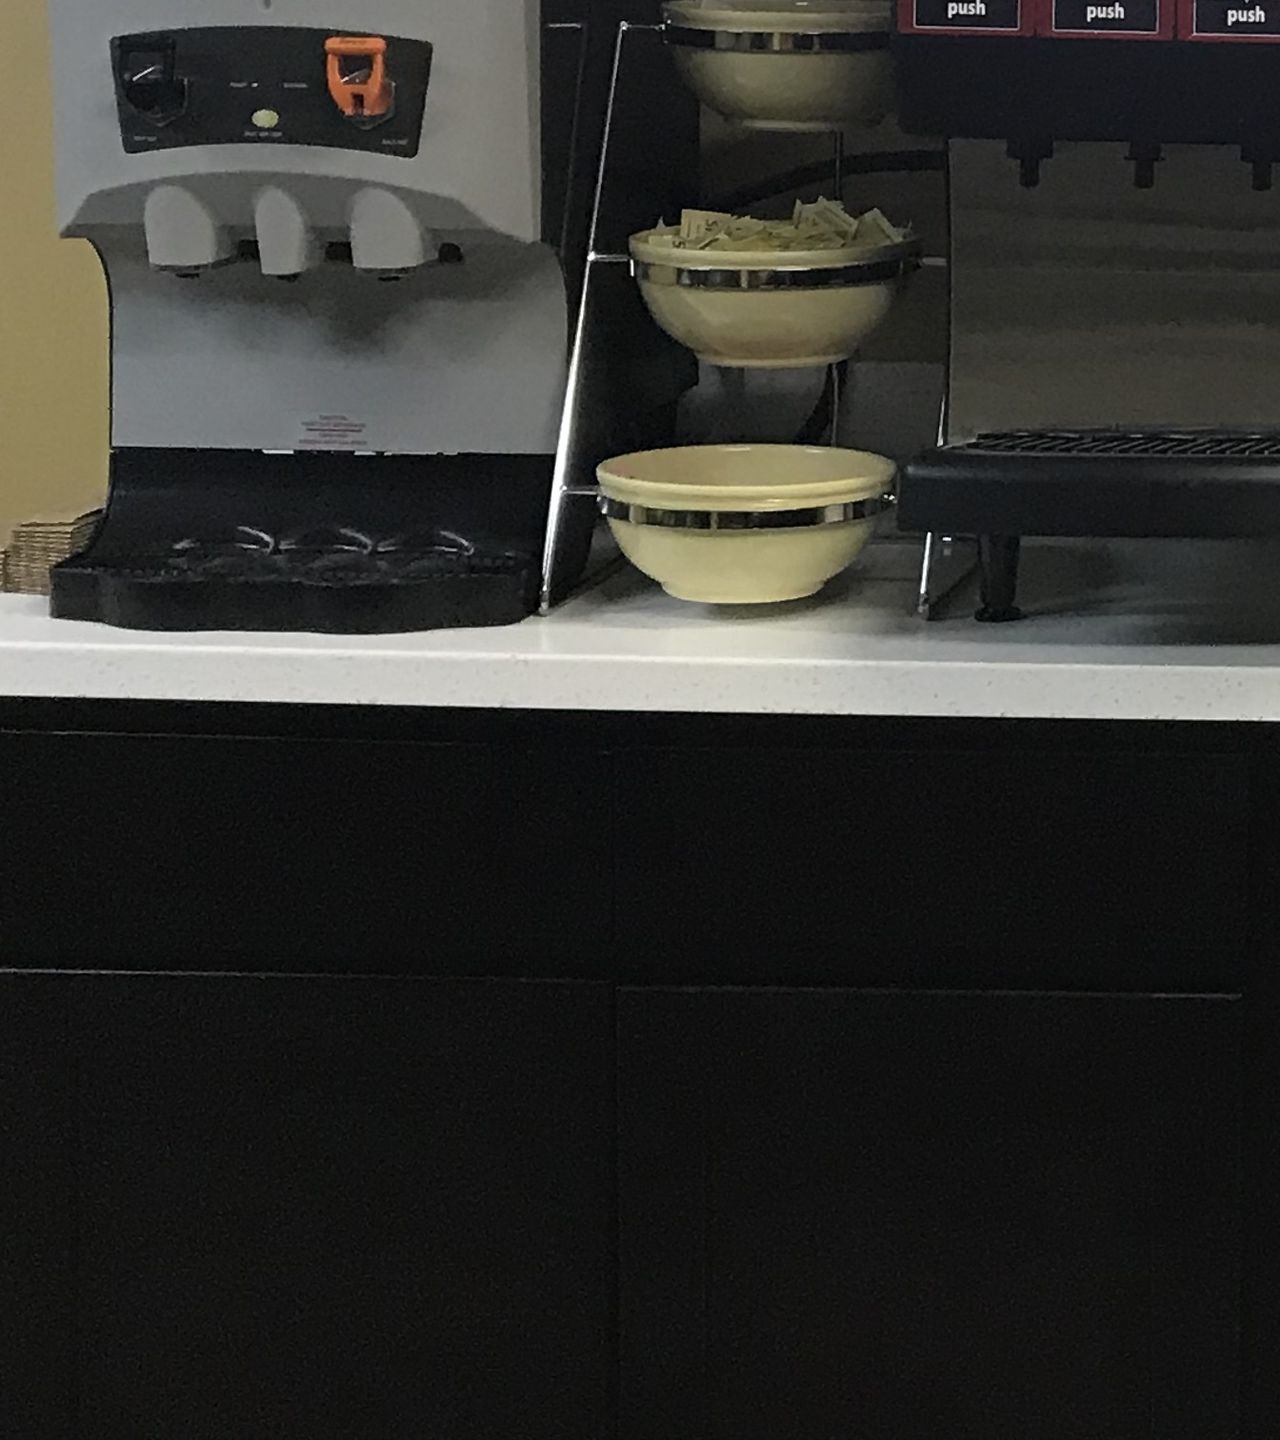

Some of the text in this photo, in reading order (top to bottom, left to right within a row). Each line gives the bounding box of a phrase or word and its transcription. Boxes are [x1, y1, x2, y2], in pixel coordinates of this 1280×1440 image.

[948, 0, 986, 19] push
[1087, 3, 1125, 22] push
[1227, 6, 1266, 27] push
